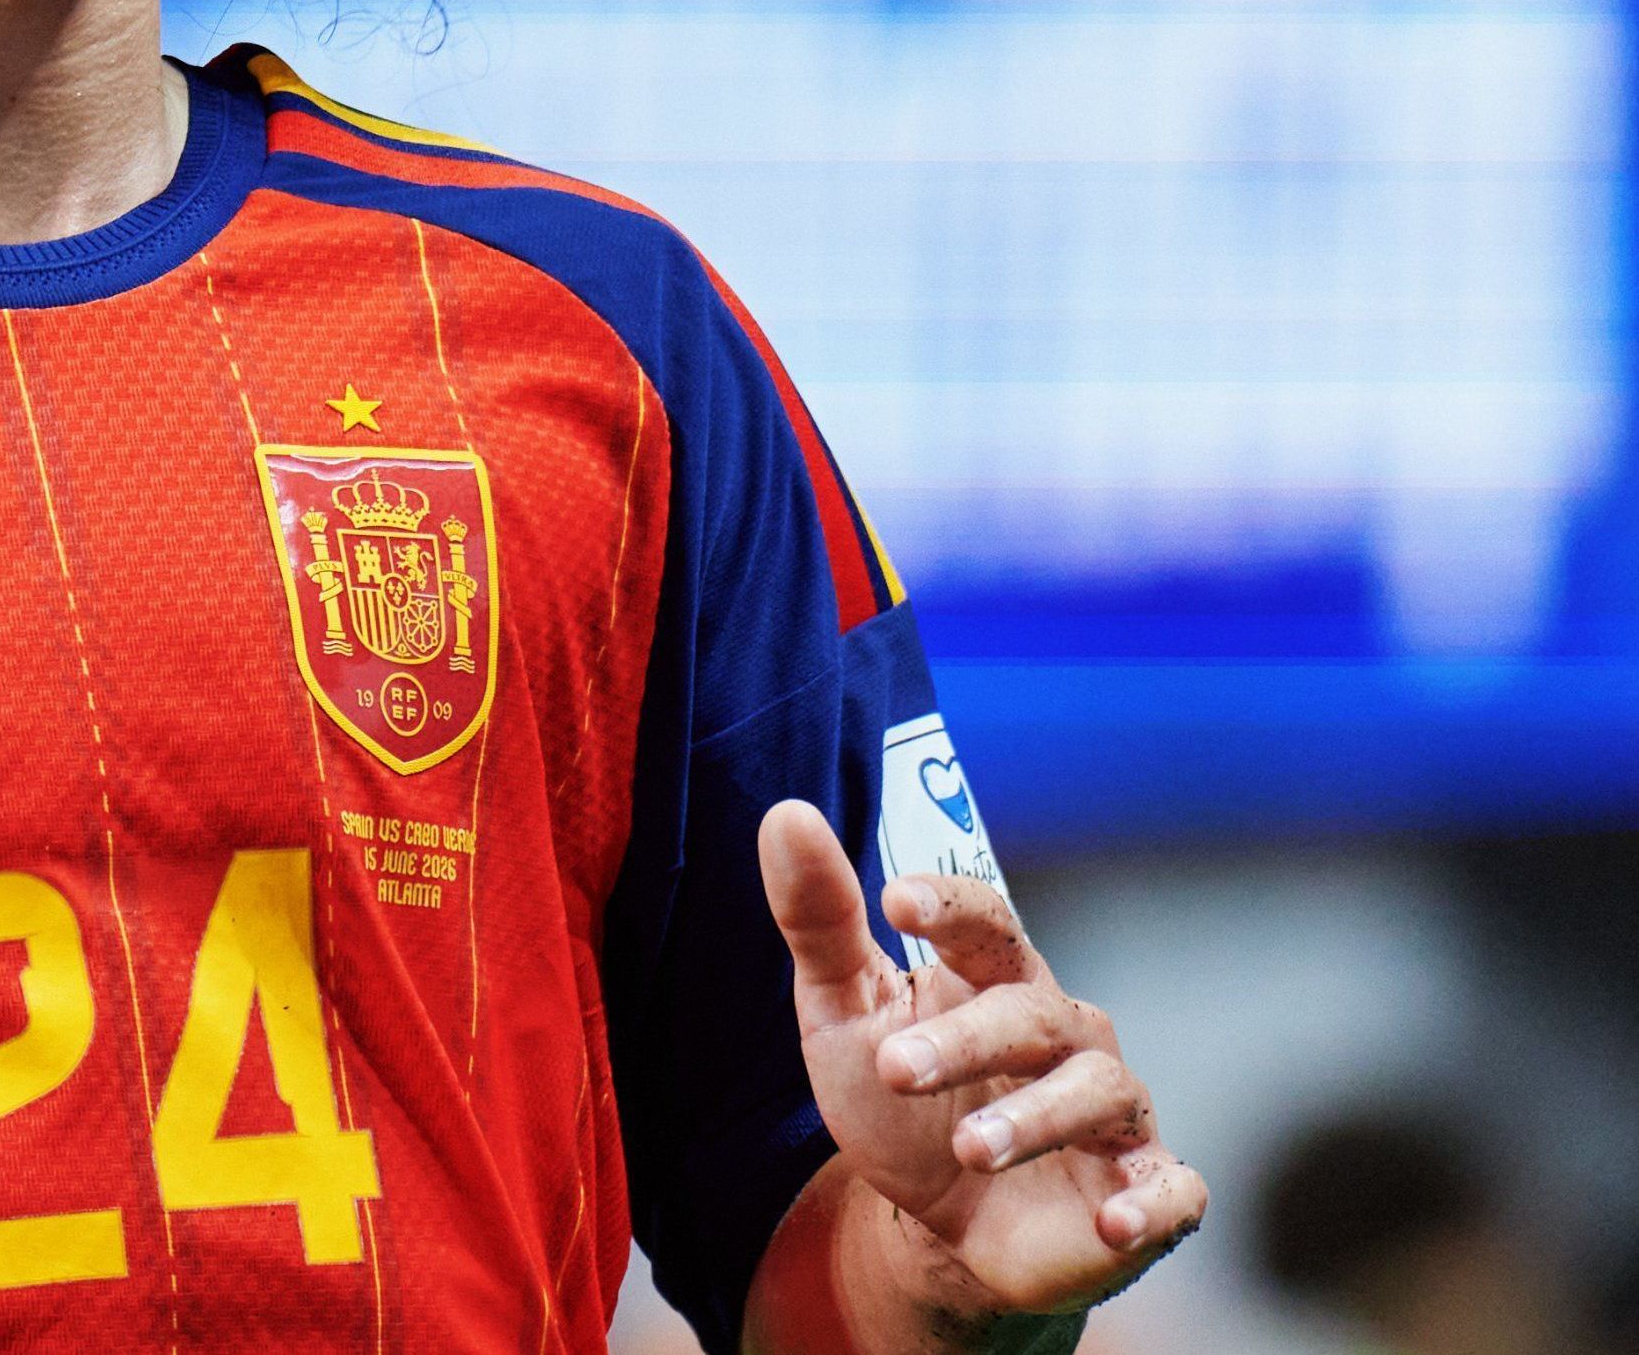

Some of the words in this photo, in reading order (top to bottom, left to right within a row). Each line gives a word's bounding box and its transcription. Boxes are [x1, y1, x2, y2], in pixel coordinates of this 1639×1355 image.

[355, 688, 375, 709] 19
[391, 686, 418, 704] RF
[391, 705, 418, 722] EF
[432, 699, 453, 721] 09
[341, 810, 374, 840] SPAIN
[405, 820, 439, 848] CABO
[364, 846, 378, 871] 15
[380, 849, 418, 876] JUNE
[422, 854, 457, 882] 2026
[378, 878, 442, 909] ATLANTA
